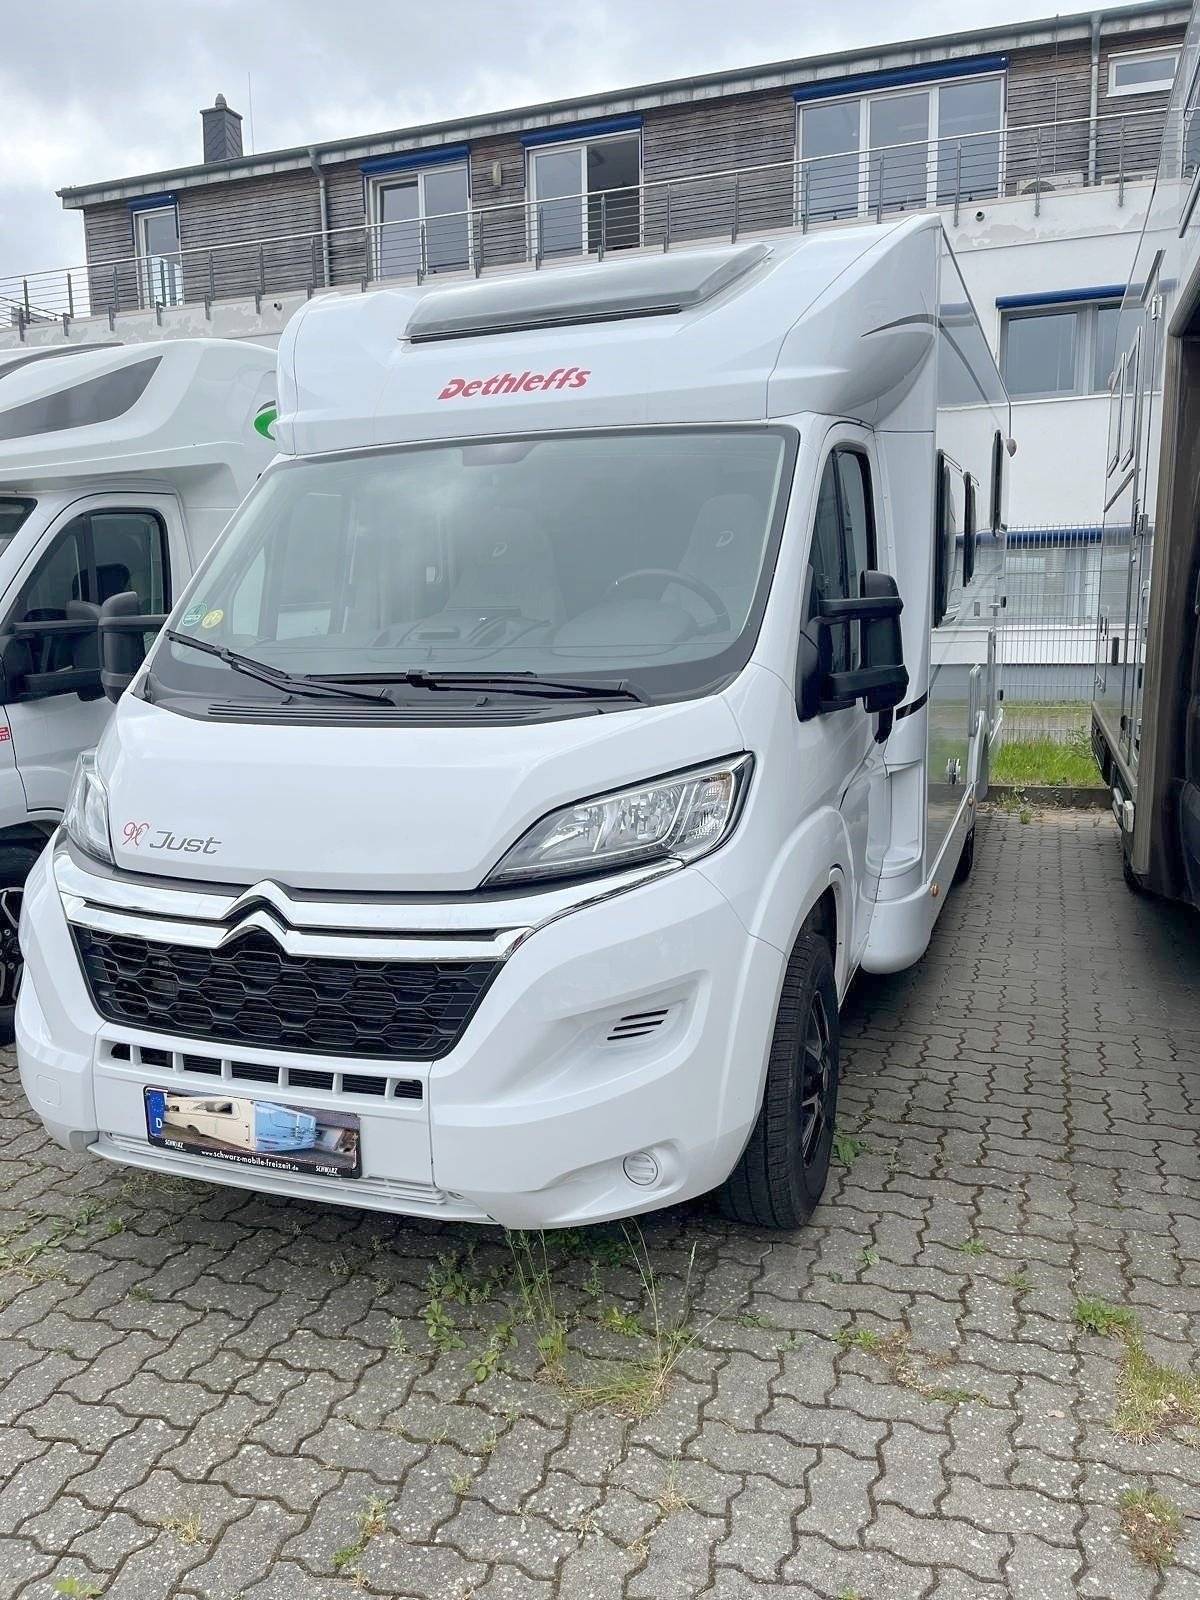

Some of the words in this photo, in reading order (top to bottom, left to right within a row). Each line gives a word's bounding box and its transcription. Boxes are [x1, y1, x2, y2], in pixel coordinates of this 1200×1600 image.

[438, 367, 591, 400] Dethleffs
[149, 830, 223, 855] Just
[156, 1117, 163, 1129] D
[200, 1149, 299, 1171] www.schwarz-mobile-freizeit.de
